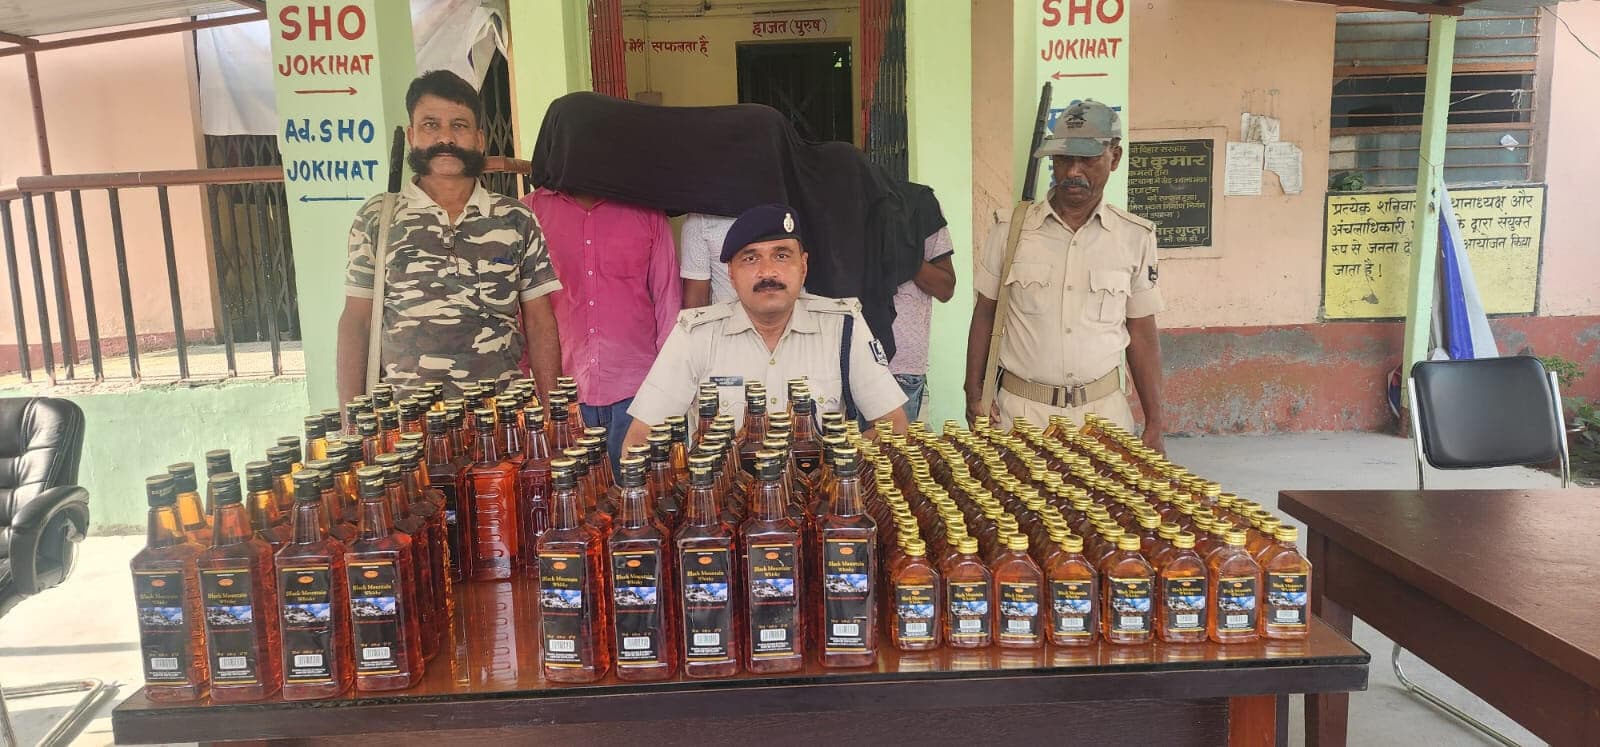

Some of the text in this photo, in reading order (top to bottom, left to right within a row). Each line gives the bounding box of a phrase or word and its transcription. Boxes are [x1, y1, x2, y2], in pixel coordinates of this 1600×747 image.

[278, 5, 366, 41] SHO
[1042, 0, 1124, 27] SHO
[752, 20, 788, 37] हाजत
[651, 41, 698, 54] सफलता
[699, 35, 709, 57] है
[1041, 38, 1122, 61] JOKIHAT
[278, 54, 374, 76] JOKIHAT
[287, 160, 378, 182] JOKIHAT
[1332, 198, 1371, 215] प्रत्येक
[1511, 190, 1533, 208] और
[1330, 217, 1406, 236] अंचलाधिकारी
[1498, 212, 1532, 231] संयुक्त
[1352, 239, 1362, 255] से
[1367, 242, 1398, 253] जनता
[1511, 233, 1532, 247] किया
[1333, 264, 1361, 276] जाता
[1364, 258, 1374, 280] है
